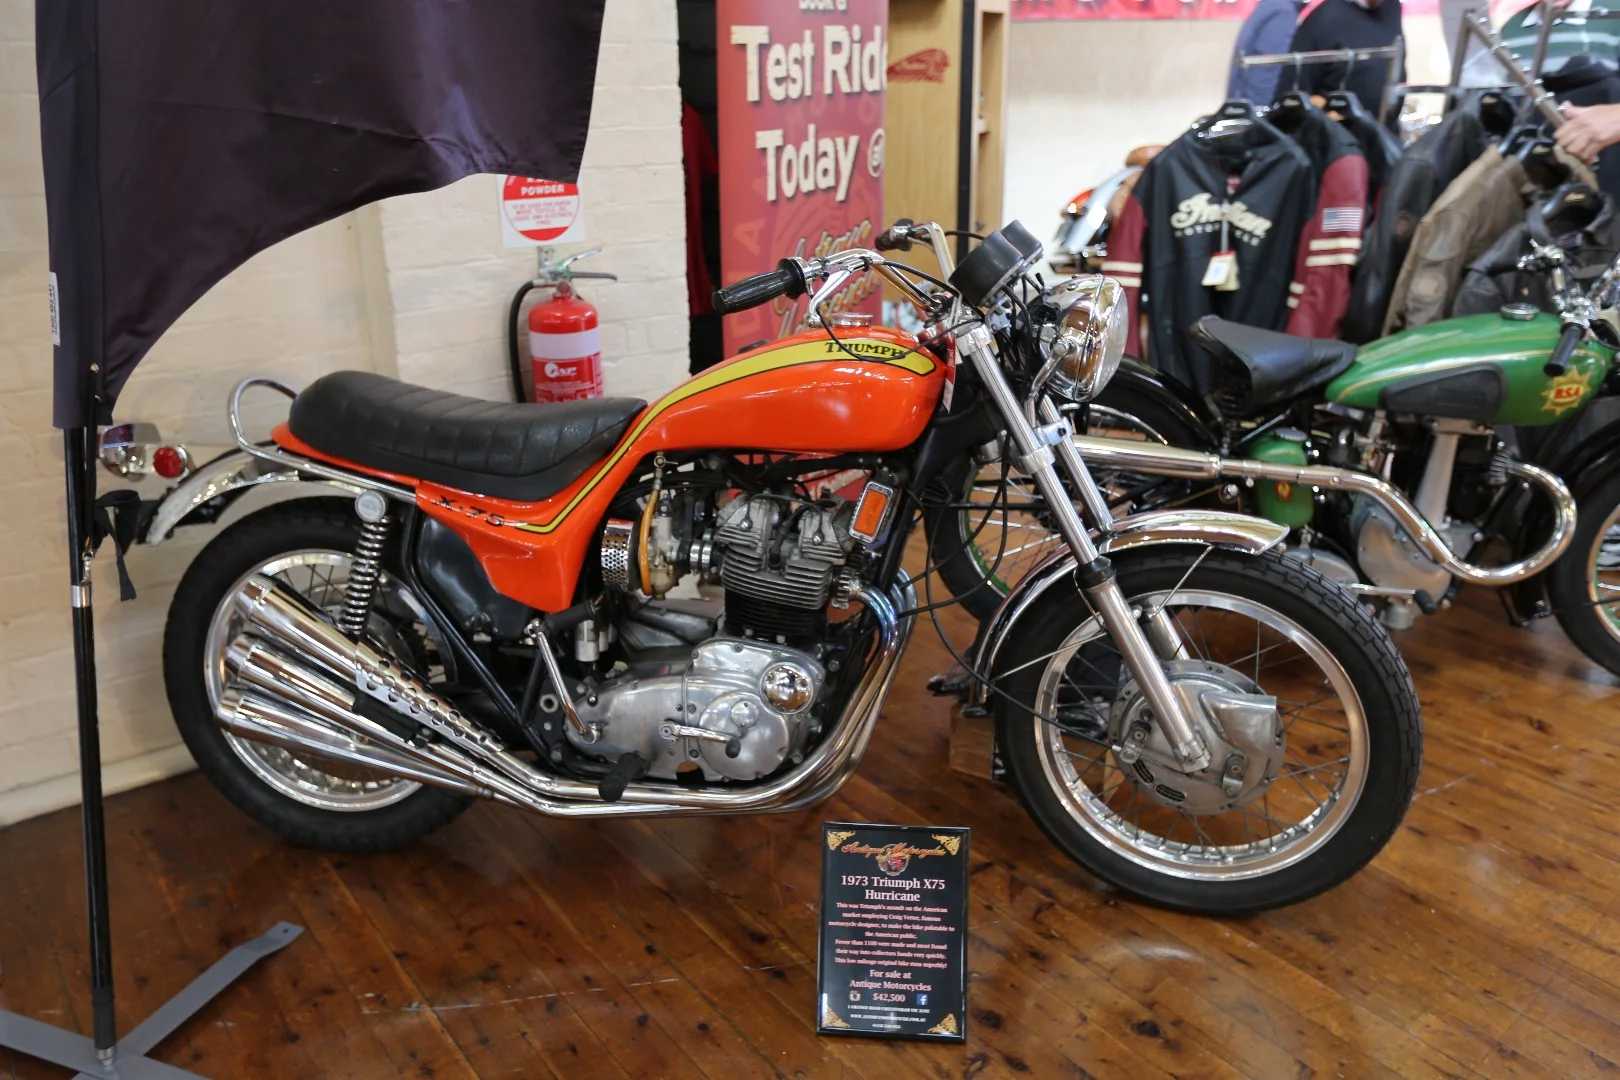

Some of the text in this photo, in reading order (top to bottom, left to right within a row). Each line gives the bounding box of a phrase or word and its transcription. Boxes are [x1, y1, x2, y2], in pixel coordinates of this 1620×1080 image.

[730, 25, 815, 102] Test
[755, 123, 860, 202] Today
[520, 183, 565, 197] POWDER
[824, 342, 905, 358] TRIUMPH
[1554, 386, 1581, 399] BSA
[841, 875, 946, 891] 1973 Triumph X75
[865, 889, 921, 902] Hurricane
[870, 969, 912, 979] For sale at
[849, 979, 932, 992] Antique Motorcycles
[872, 993, 906, 1002] $42,500
